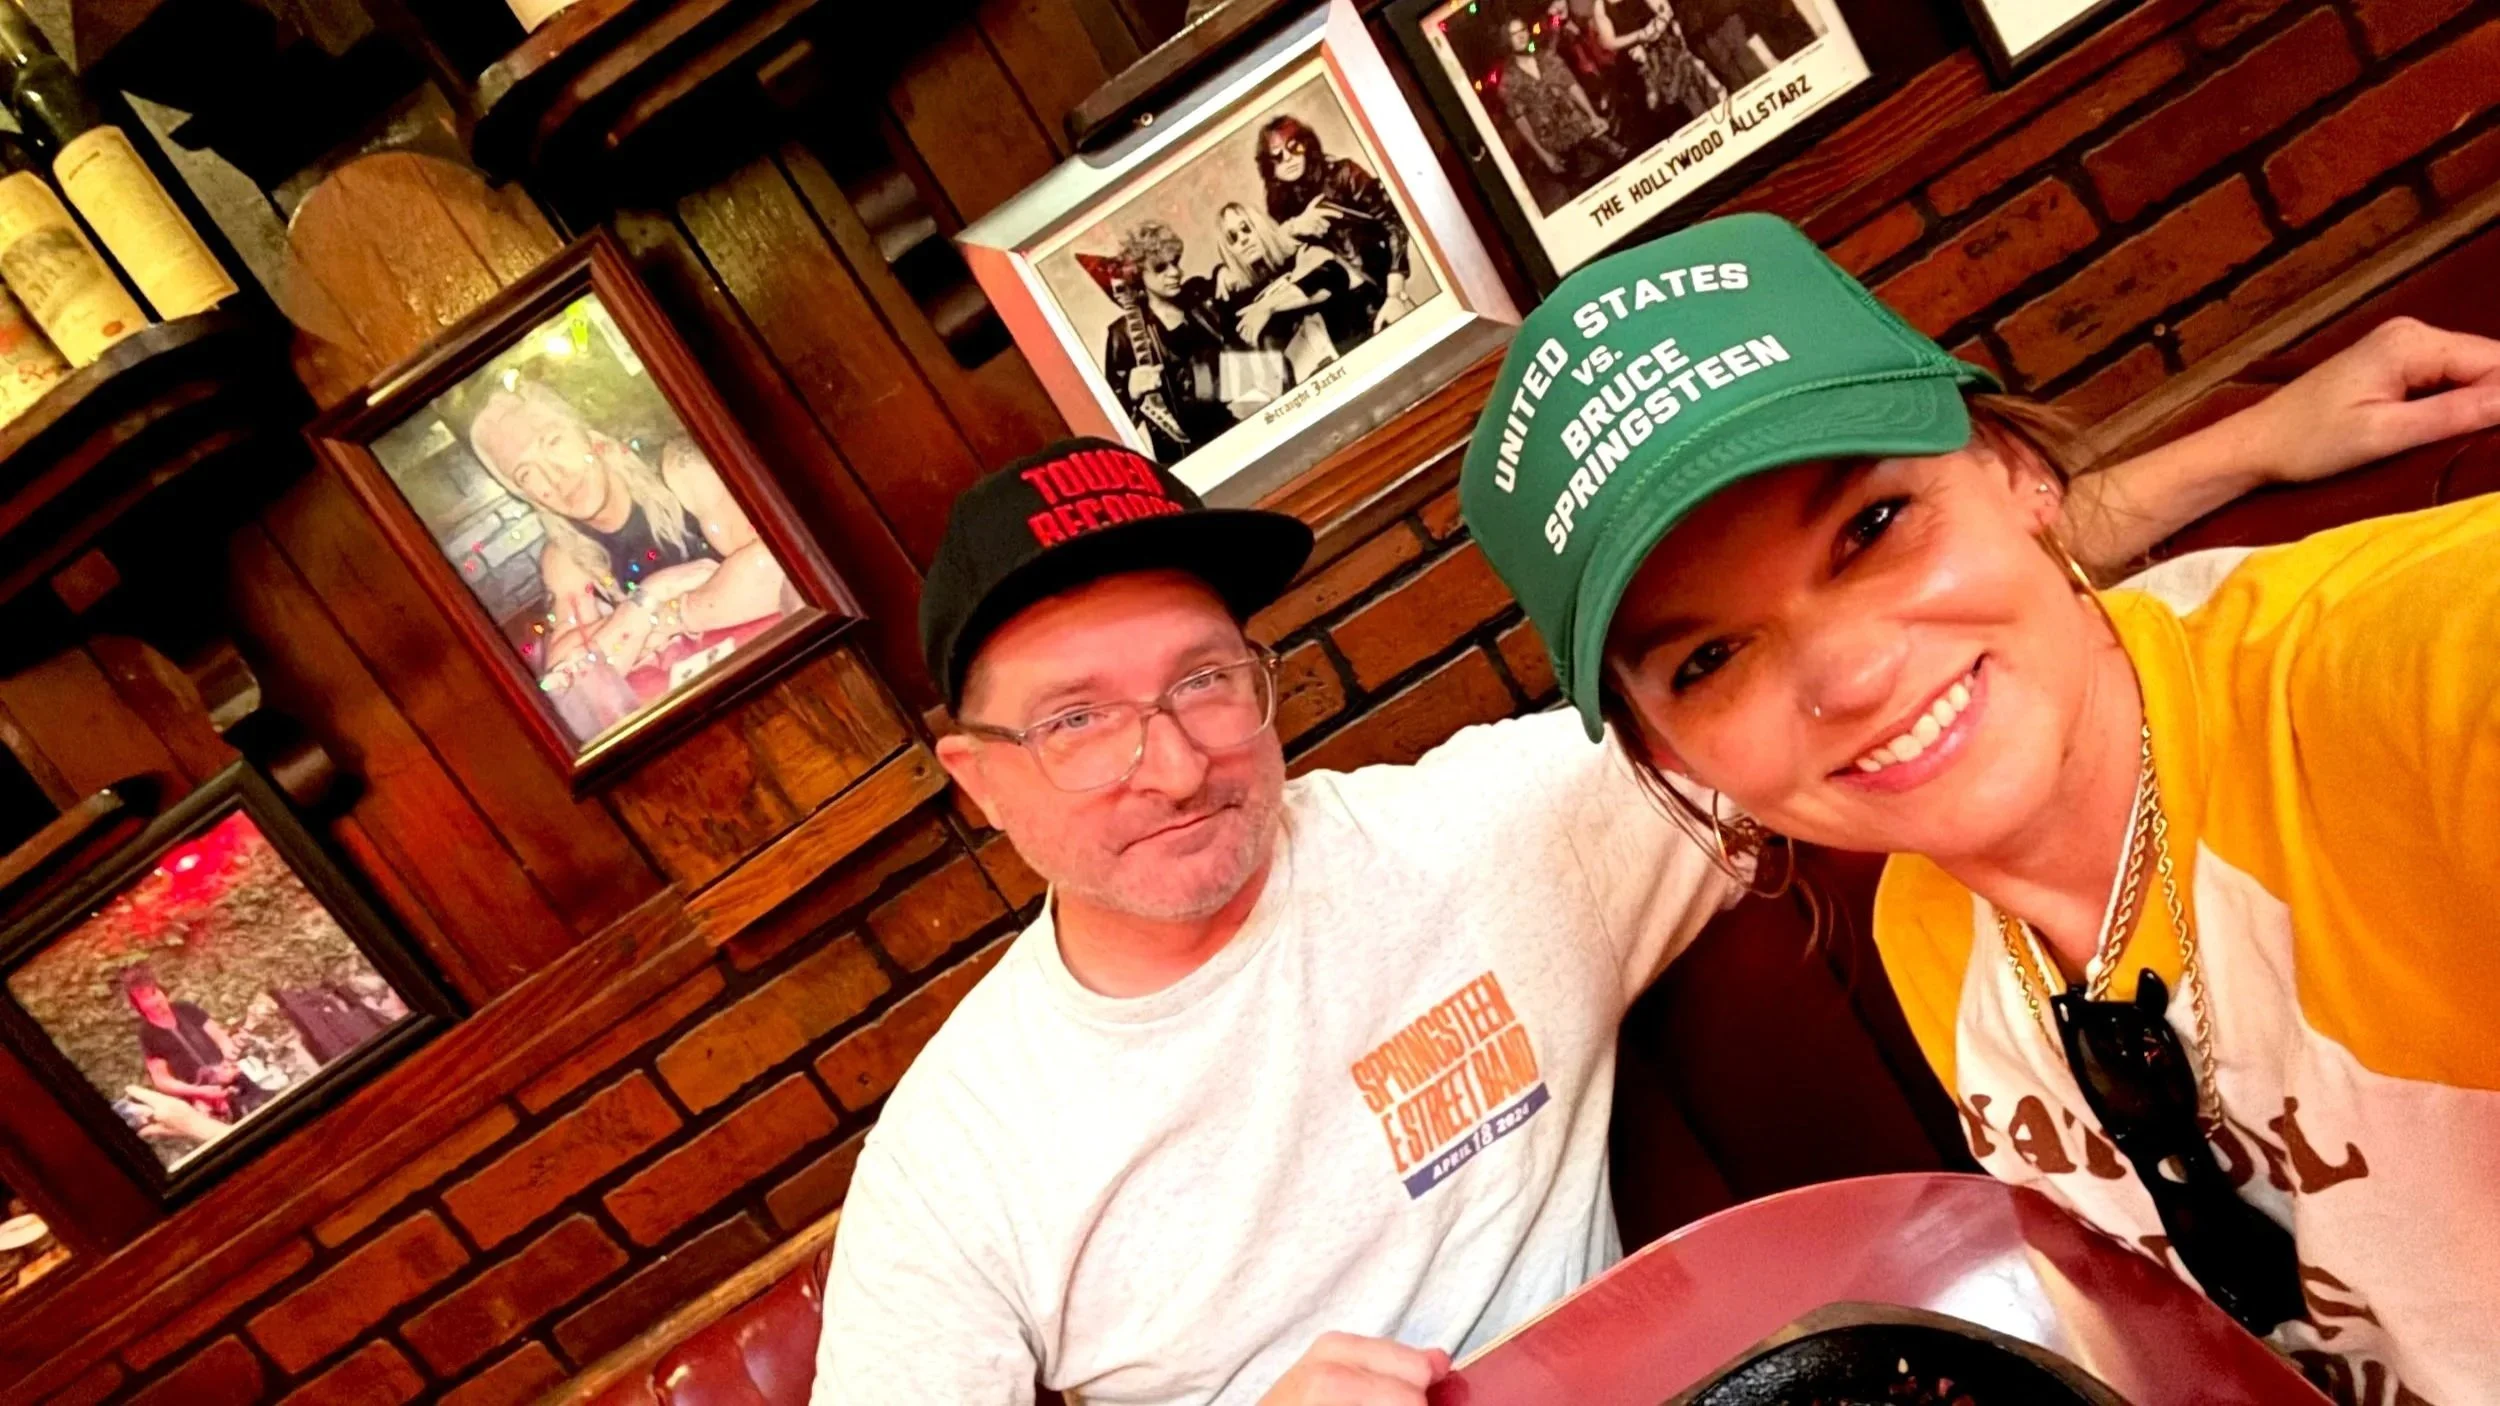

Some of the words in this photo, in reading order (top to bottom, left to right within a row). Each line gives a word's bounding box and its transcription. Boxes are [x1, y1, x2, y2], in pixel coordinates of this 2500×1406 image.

[1588, 195, 1625, 228] THE
[1628, 129, 1725, 205] HOLLYWOOD
[1728, 74, 1813, 136] ALLSTARZ
[1263, 389, 1311, 425] Straight
[1310, 365, 1348, 397] Jacket
[1494, 337, 1569, 494] UNITED
[1572, 262, 1749, 339] STATES
[1543, 334, 1791, 556] SPRINGSTEEN
[1559, 337, 1691, 461] BRUCE
[1350, 969, 1517, 1117] SPRINGSTEEN
[1379, 1111, 1409, 1176] E
[1396, 1056, 1483, 1165] STREET
[1469, 1022, 1541, 1112] BAND
[1431, 1142, 1473, 1181] APRIL
[1471, 1121, 1495, 1153] 18
